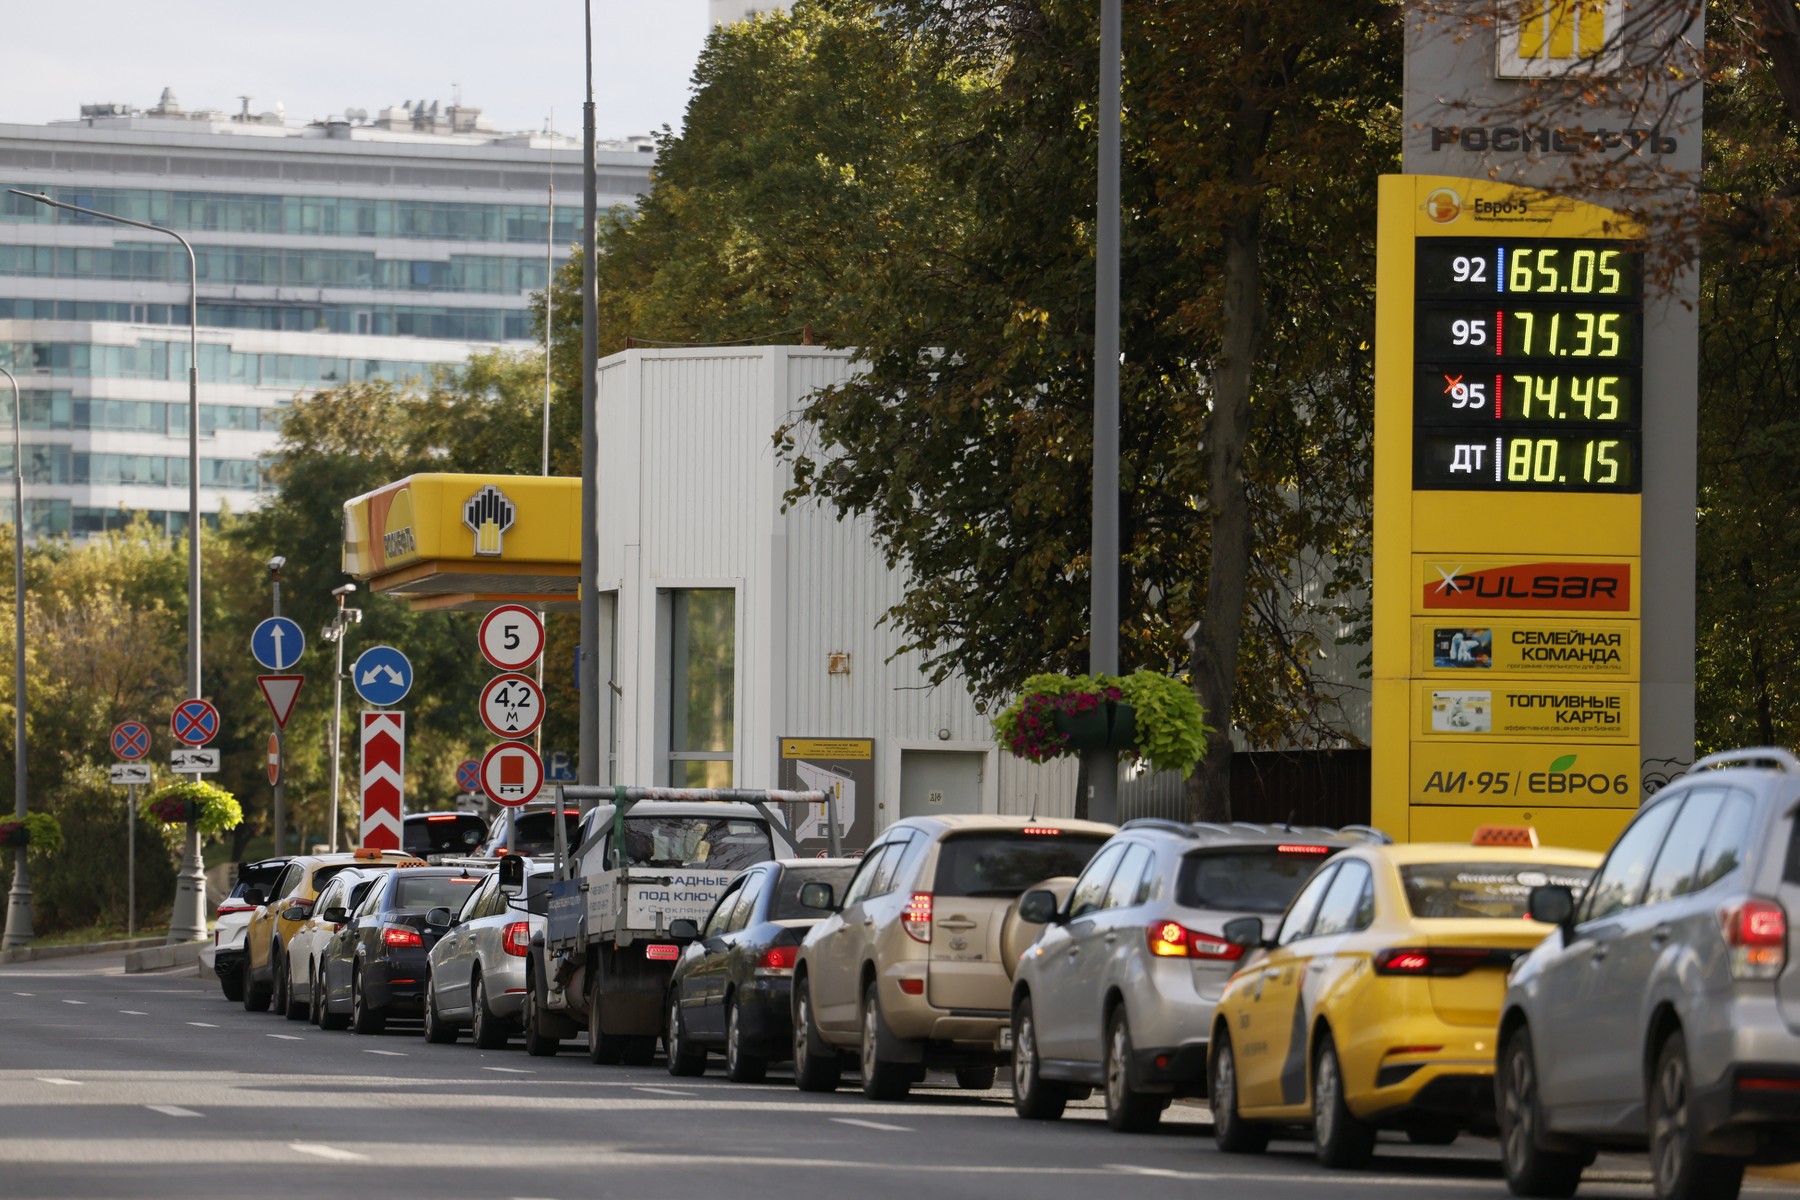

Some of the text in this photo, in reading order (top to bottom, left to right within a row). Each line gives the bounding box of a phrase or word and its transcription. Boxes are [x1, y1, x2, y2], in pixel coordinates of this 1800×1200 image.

[1452, 248, 1621, 293] 92 65.05
[1451, 312, 1620, 357] 95 71.35
[1451, 375, 1619, 420] 95 74.45
[1449, 438, 1619, 483] ДТ 80.15
[503, 625, 520, 650] 5
[1511, 629, 1621, 646] СЕМЕЙНАЯ
[1522, 647, 1621, 665] КОМАНДА
[494, 686, 531, 710] 4,2
[1506, 694, 1621, 709] ТОПЛИВНЫЕ
[1556, 710, 1621, 724] КАРТЫ
[639, 891, 718, 902] ПОД КЛЮЧ
